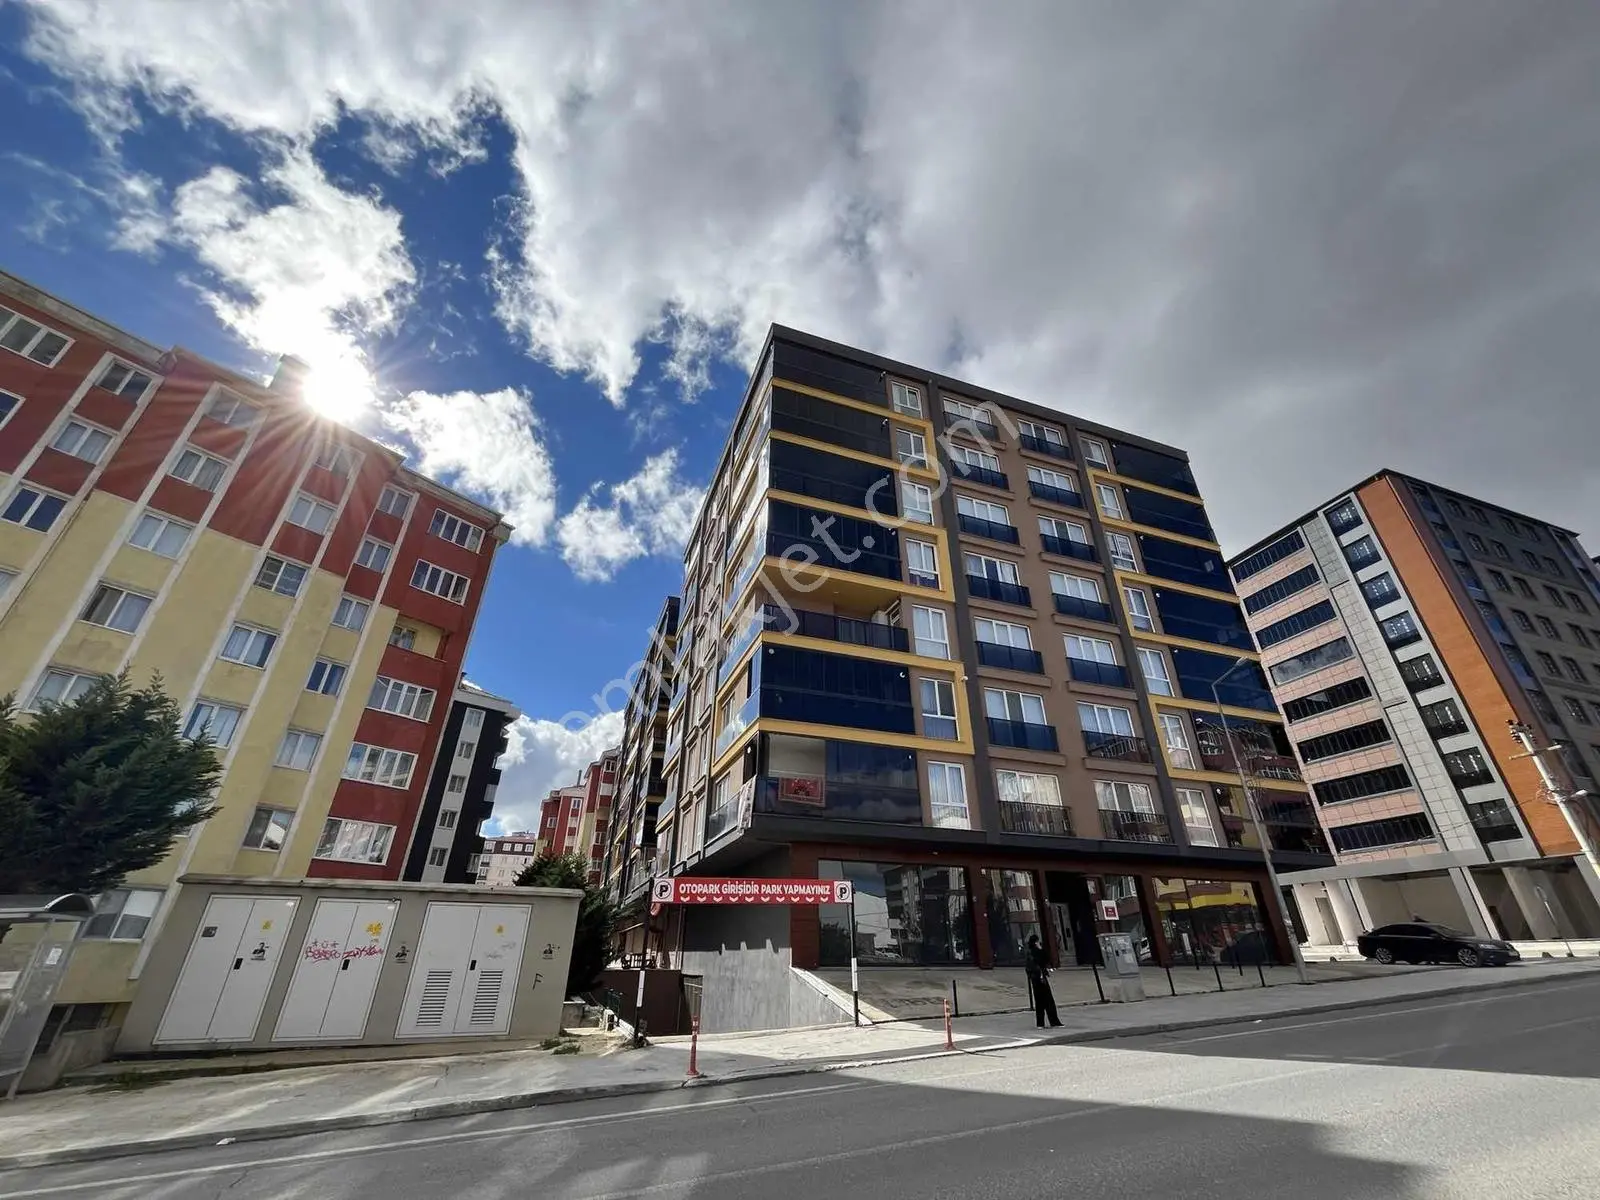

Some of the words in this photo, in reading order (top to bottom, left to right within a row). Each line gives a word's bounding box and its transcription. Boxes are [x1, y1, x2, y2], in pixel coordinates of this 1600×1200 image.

[679, 883, 720, 895] OTOPARK
[721, 881, 760, 897] GİRİŞİDİR
[761, 883, 782, 895] PARK
[783, 884, 831, 895] YAPMAYINIZ
